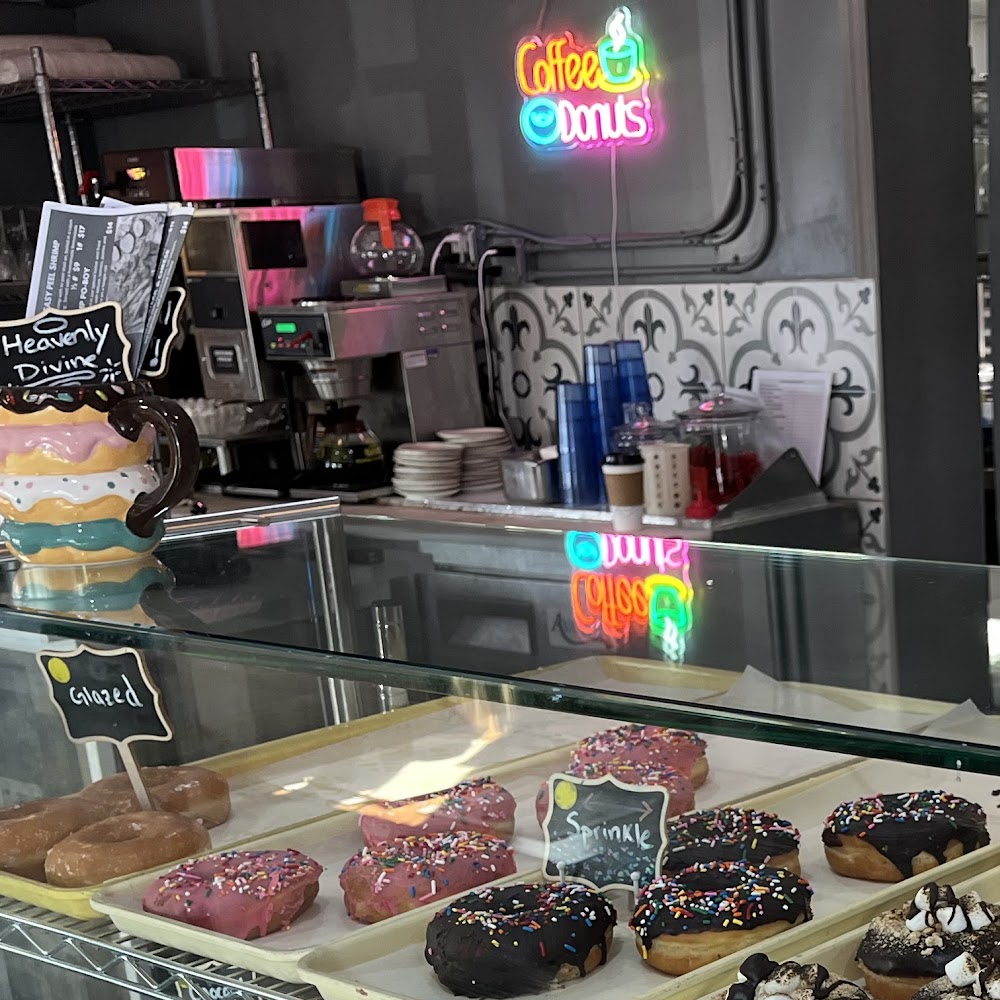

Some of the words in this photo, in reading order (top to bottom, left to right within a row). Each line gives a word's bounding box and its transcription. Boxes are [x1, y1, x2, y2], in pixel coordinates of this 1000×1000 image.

[516, 38, 601, 96] Coffee
[557, 94, 649, 143] Donuts
[49, 239, 60, 271] SHRIMP
[46, 272, 56, 291] PEEL
[80, 266, 91, 300] PO-BOY
[2, 319, 110, 356] Heavenly
[13, 354, 99, 382] Divine
[69, 673, 143, 707] Glazed
[566, 810, 654, 851] Sprinkle
